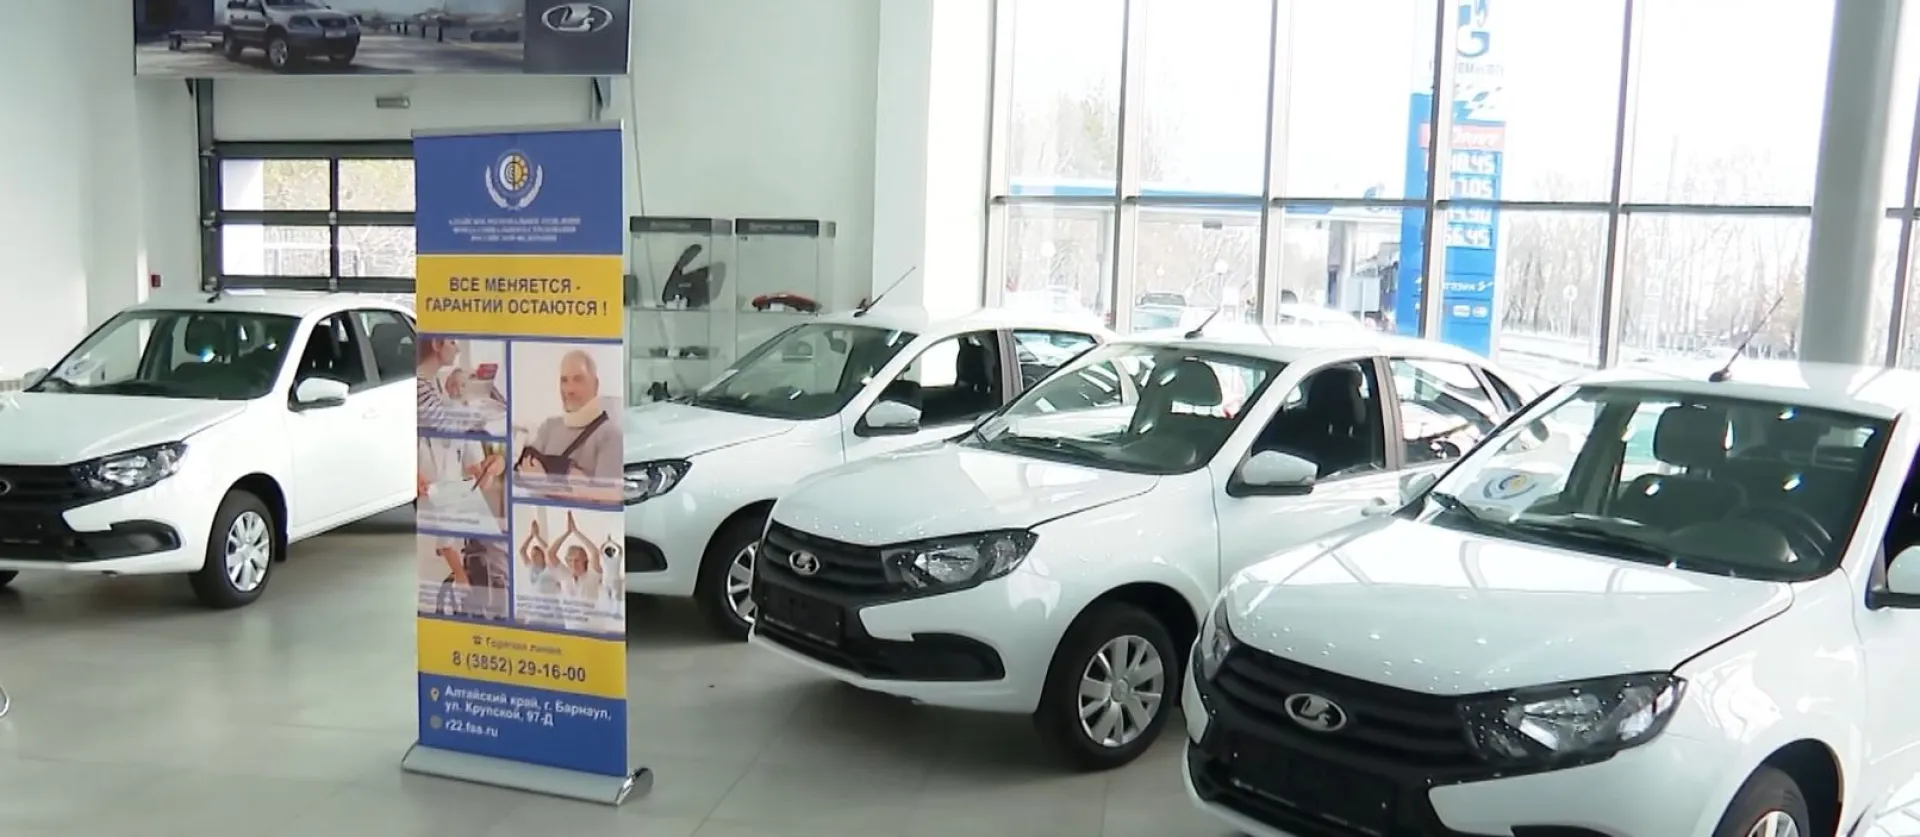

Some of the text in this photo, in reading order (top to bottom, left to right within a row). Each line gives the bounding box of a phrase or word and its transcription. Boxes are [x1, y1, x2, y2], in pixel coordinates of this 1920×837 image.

[449, 277, 480, 293] ВСЕ
[485, 277, 571, 294] МЕНЯЕТСЯ
[425, 297, 503, 315] ГАРАНТИИ
[507, 299, 598, 317] ОСТАЮТСЯ
[452, 651, 587, 682] 8 (3852) 29-16-00
[444, 701, 463, 714] ул.
[464, 702, 525, 723] Крупской,
[445, 685, 507, 704] Алтайский
[509, 694, 542, 712] край,
[554, 700, 613, 722] Барнаул,
